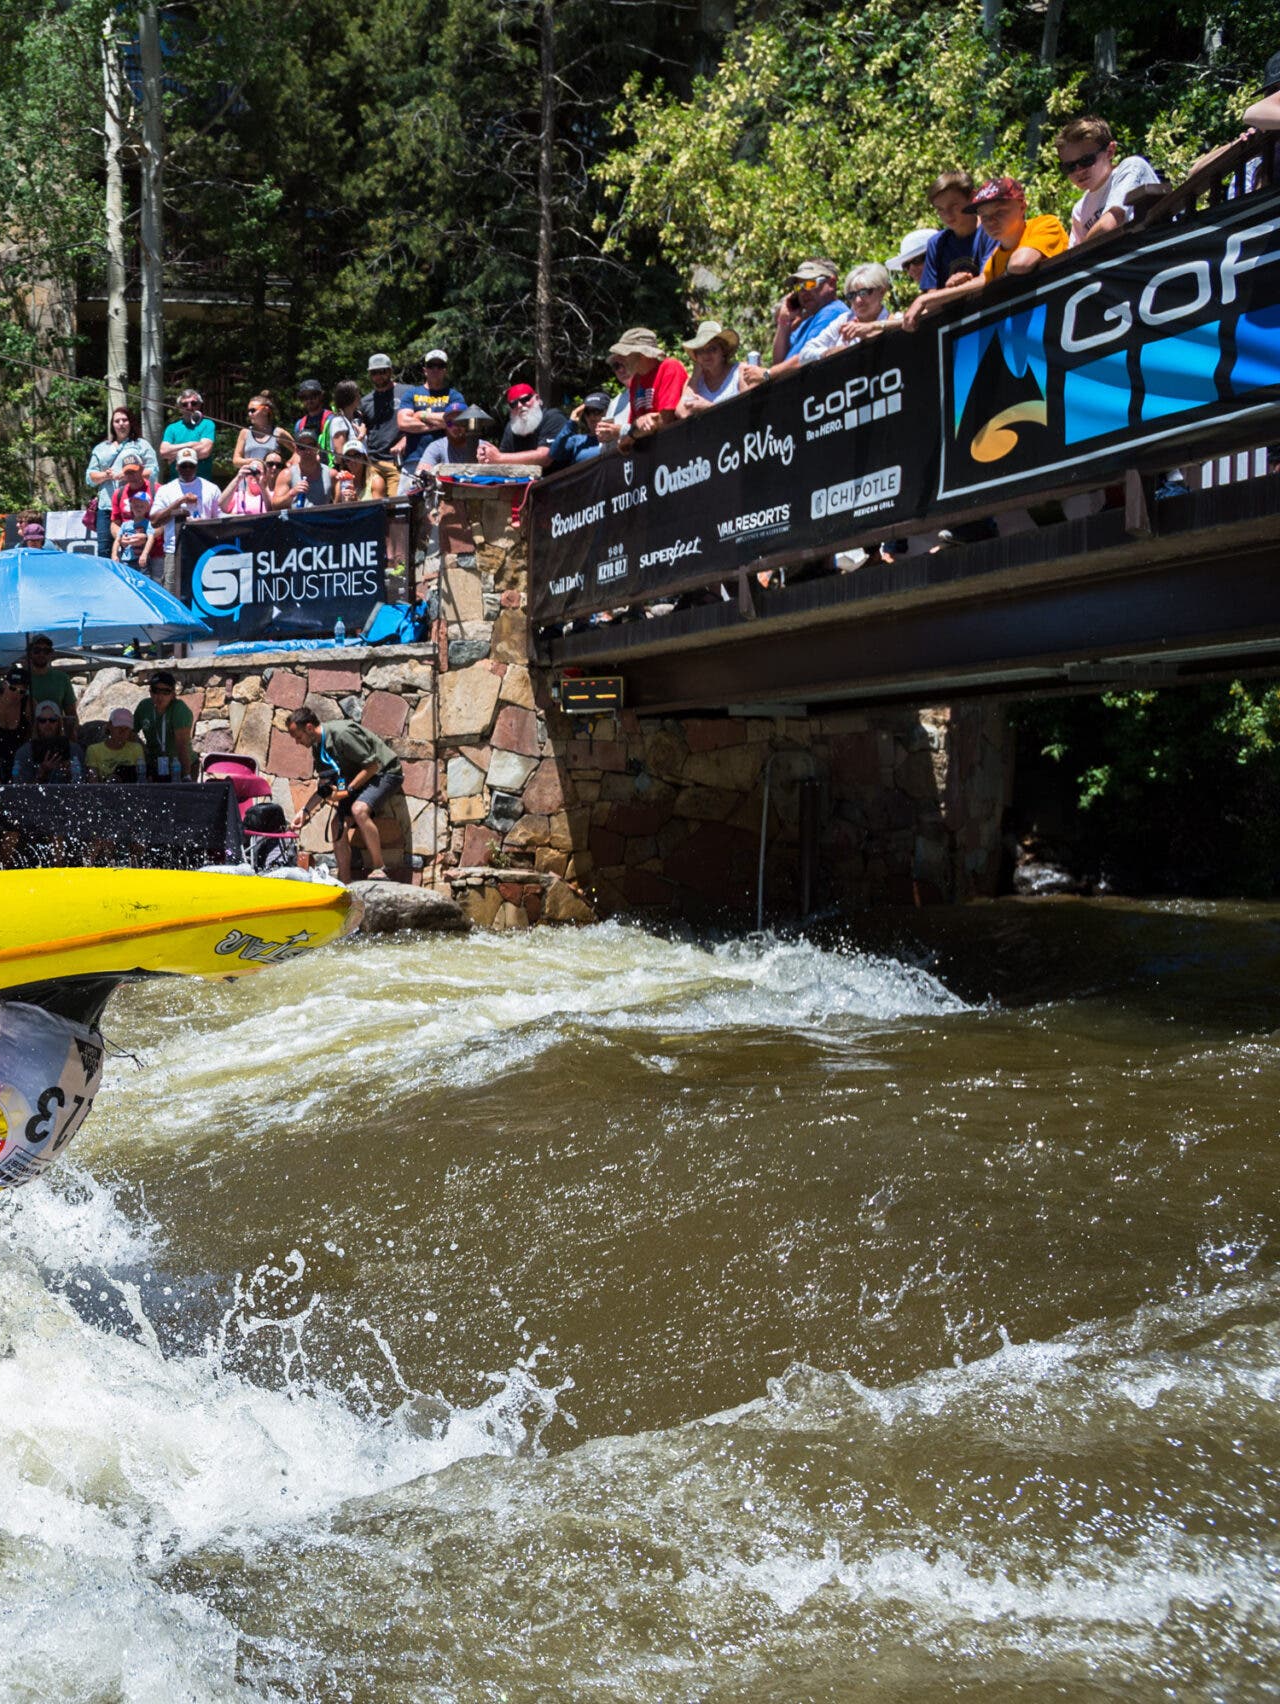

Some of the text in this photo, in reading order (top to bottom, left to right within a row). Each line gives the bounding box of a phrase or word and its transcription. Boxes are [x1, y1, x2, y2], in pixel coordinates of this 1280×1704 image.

[803, 368, 902, 422] GoPro
[718, 425, 794, 473] Go RVing
[654, 456, 711, 496] Outside
[830, 473, 896, 507] CHIPOTLE
[611, 485, 647, 514] TUDOR
[256, 541, 378, 575] SLACKLINE
[257, 570, 378, 602] INDUSTRIES
